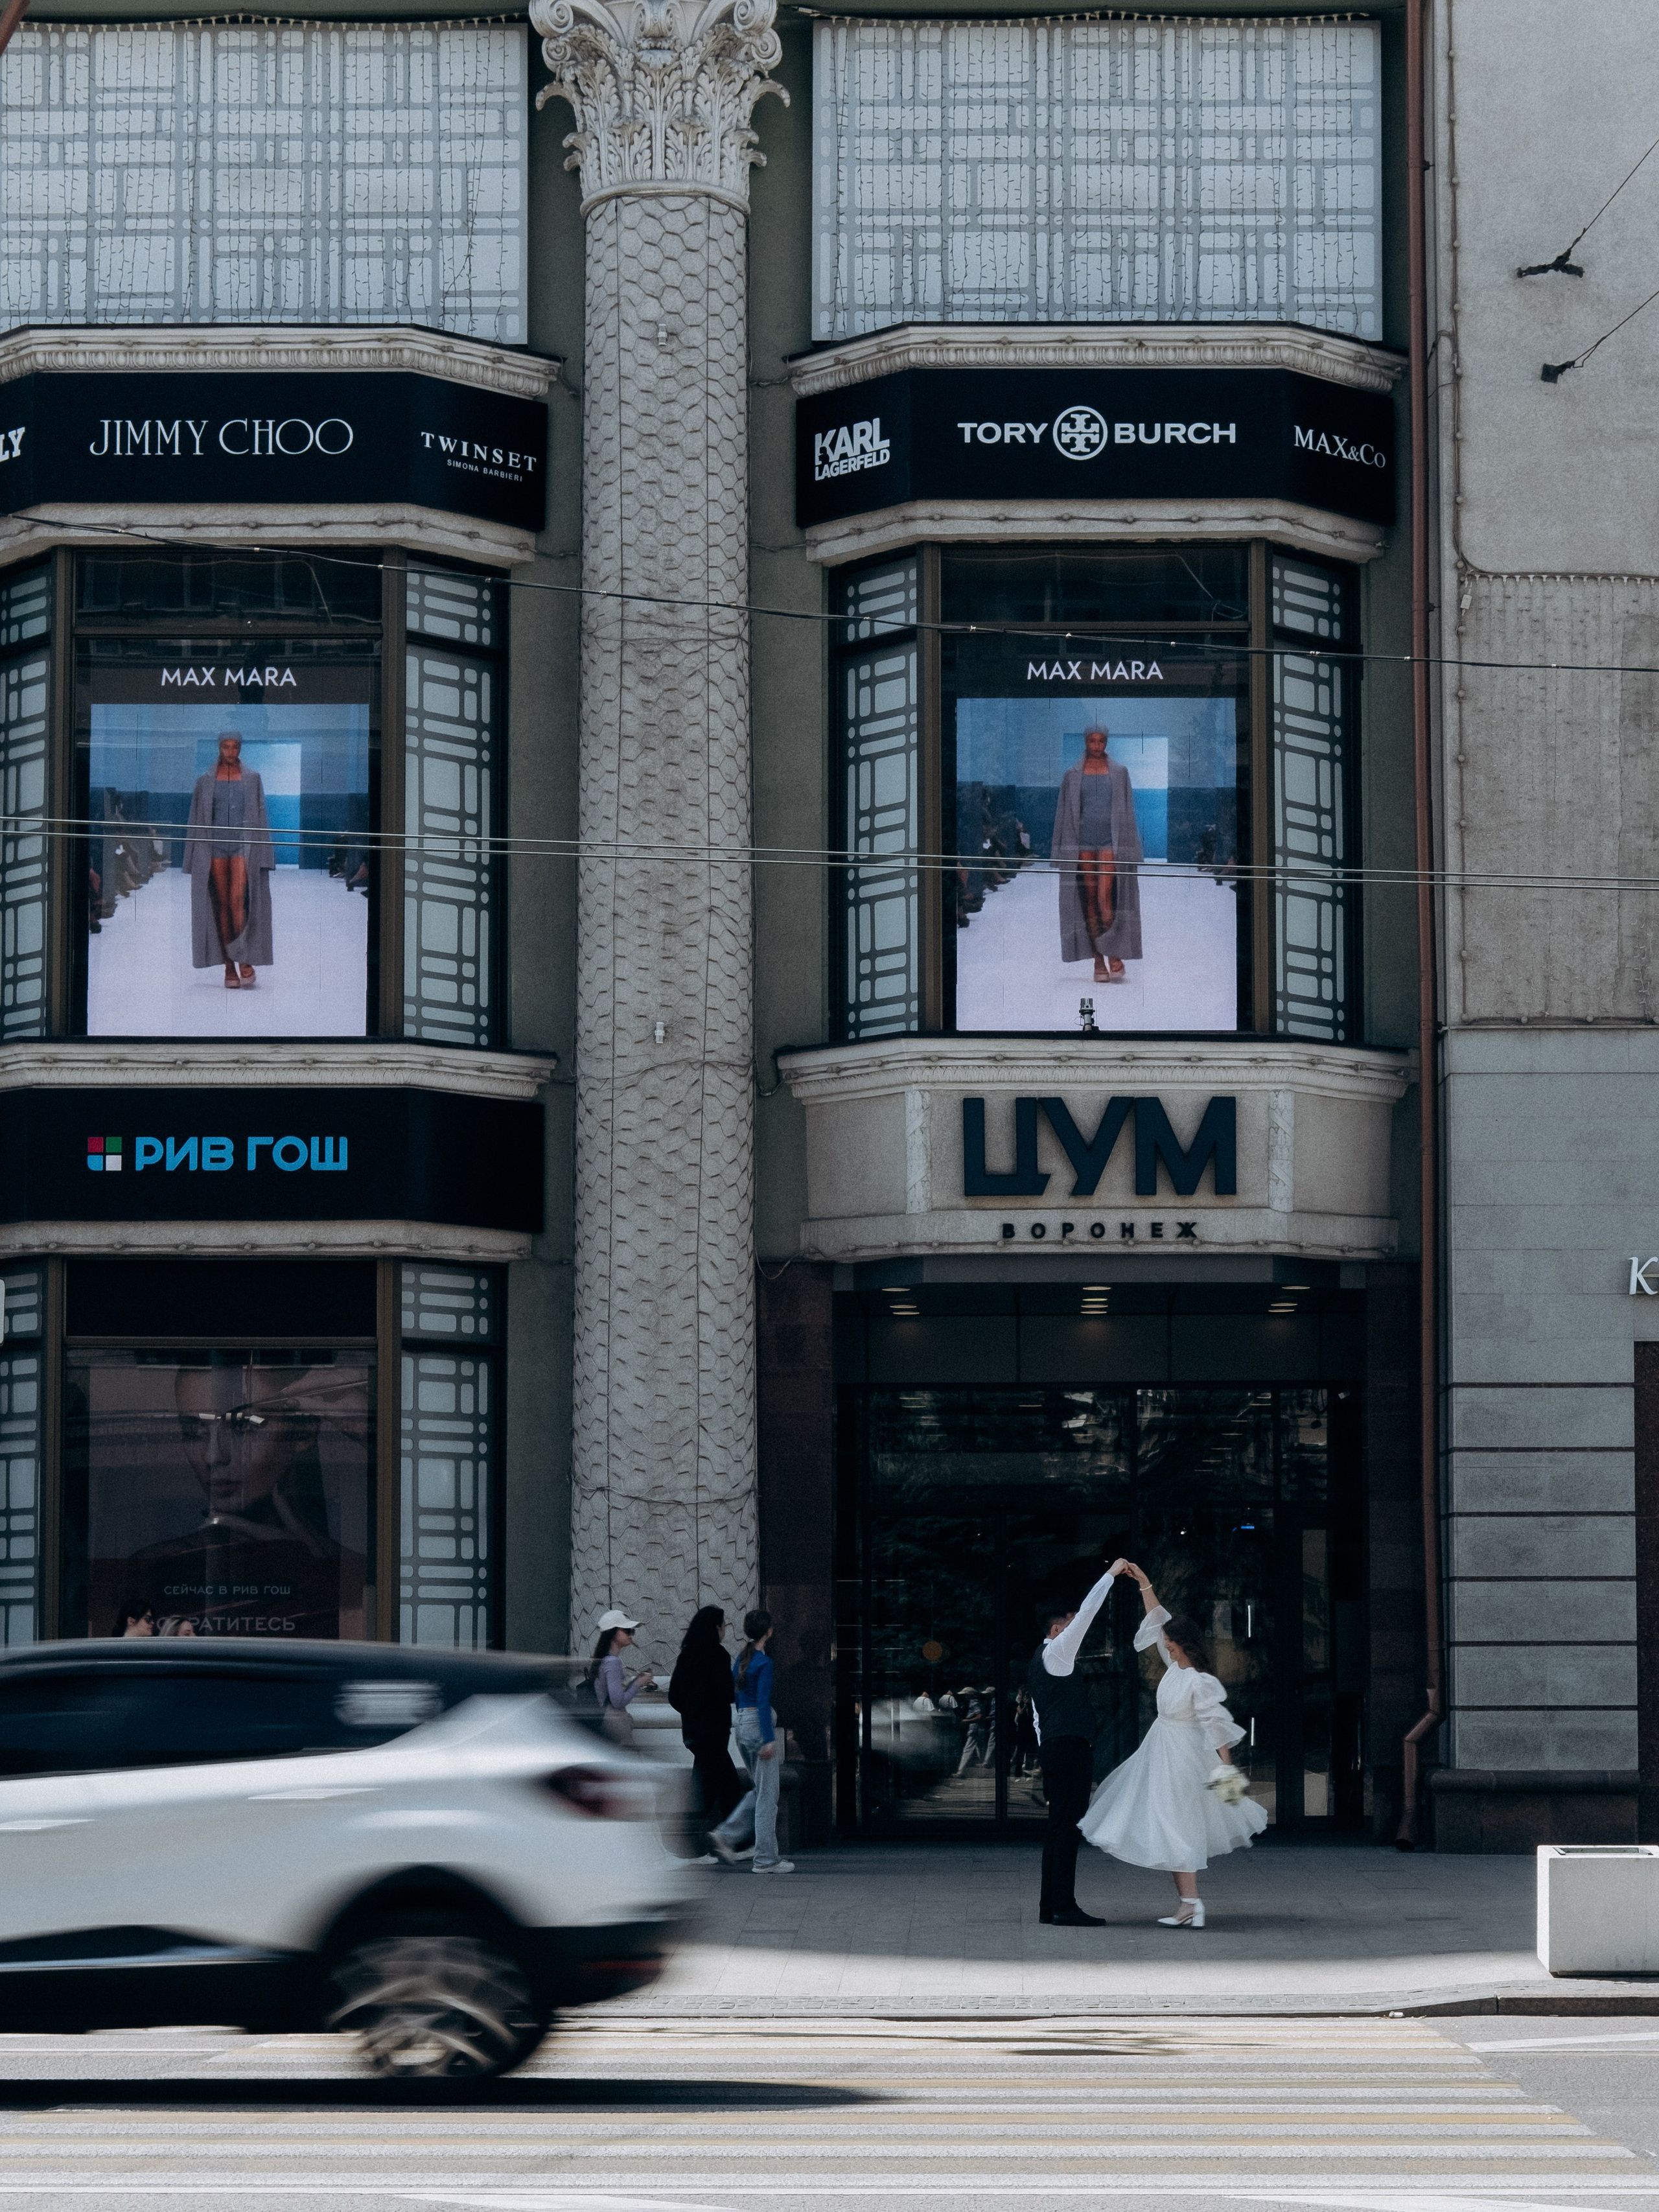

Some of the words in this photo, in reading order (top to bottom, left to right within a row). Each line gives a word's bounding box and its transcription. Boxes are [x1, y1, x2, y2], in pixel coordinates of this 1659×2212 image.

[89, 419, 208, 455] JIMMY
[219, 418, 353, 455] CHOO
[815, 417, 890, 466] KARL
[957, 423, 1049, 444] TORY
[1114, 423, 1236, 444] BURCH
[421, 431, 537, 472] TWINSET
[815, 448, 890, 481] LAGERFELD
[447, 459, 479, 472] SIMONA
[483, 467, 523, 482] BARBIERI
[161, 667, 215, 686] MAX
[224, 667, 297, 686] MARA
[1027, 660, 1082, 680] MAX
[1090, 660, 1163, 680] MARA
[135, 1136, 234, 1171] РИВ
[247, 1136, 348, 1171] ГОШ
[962, 1096, 1237, 1197] ЦУМ
[1002, 1222, 1197, 1239] ВОРОНЕЖ
[163, 1583, 214, 1595] СЕЙЧАС
[218, 1585, 227, 1595] В
[233, 1585, 259, 1595] РИВ
[264, 1585, 291, 1595] ГОШ
